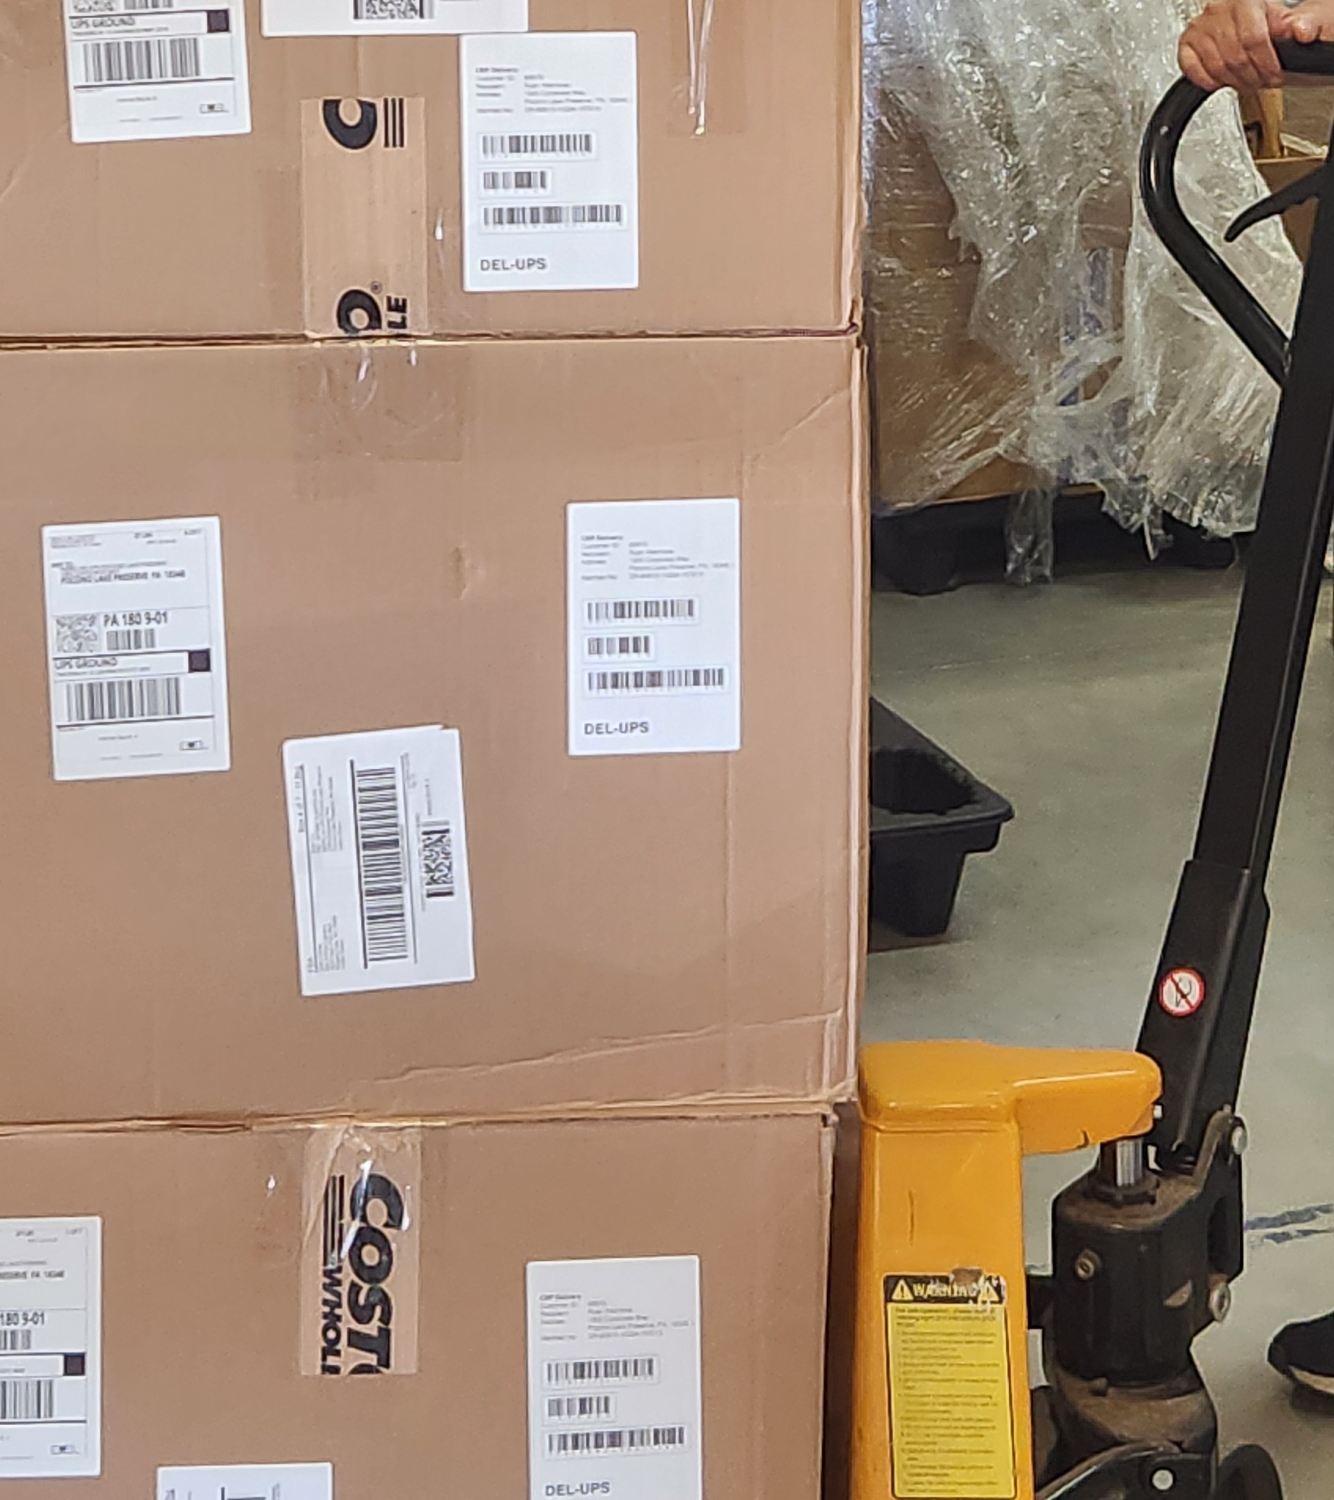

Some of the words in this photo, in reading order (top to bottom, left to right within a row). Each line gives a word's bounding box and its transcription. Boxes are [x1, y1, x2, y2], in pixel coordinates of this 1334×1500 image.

[479, 257, 547, 271] DEL-UPS
[103, 613, 119, 626] PA
[584, 721, 650, 735] DEL-UPS
[544, 1481, 611, 1497] DEL-UPS
